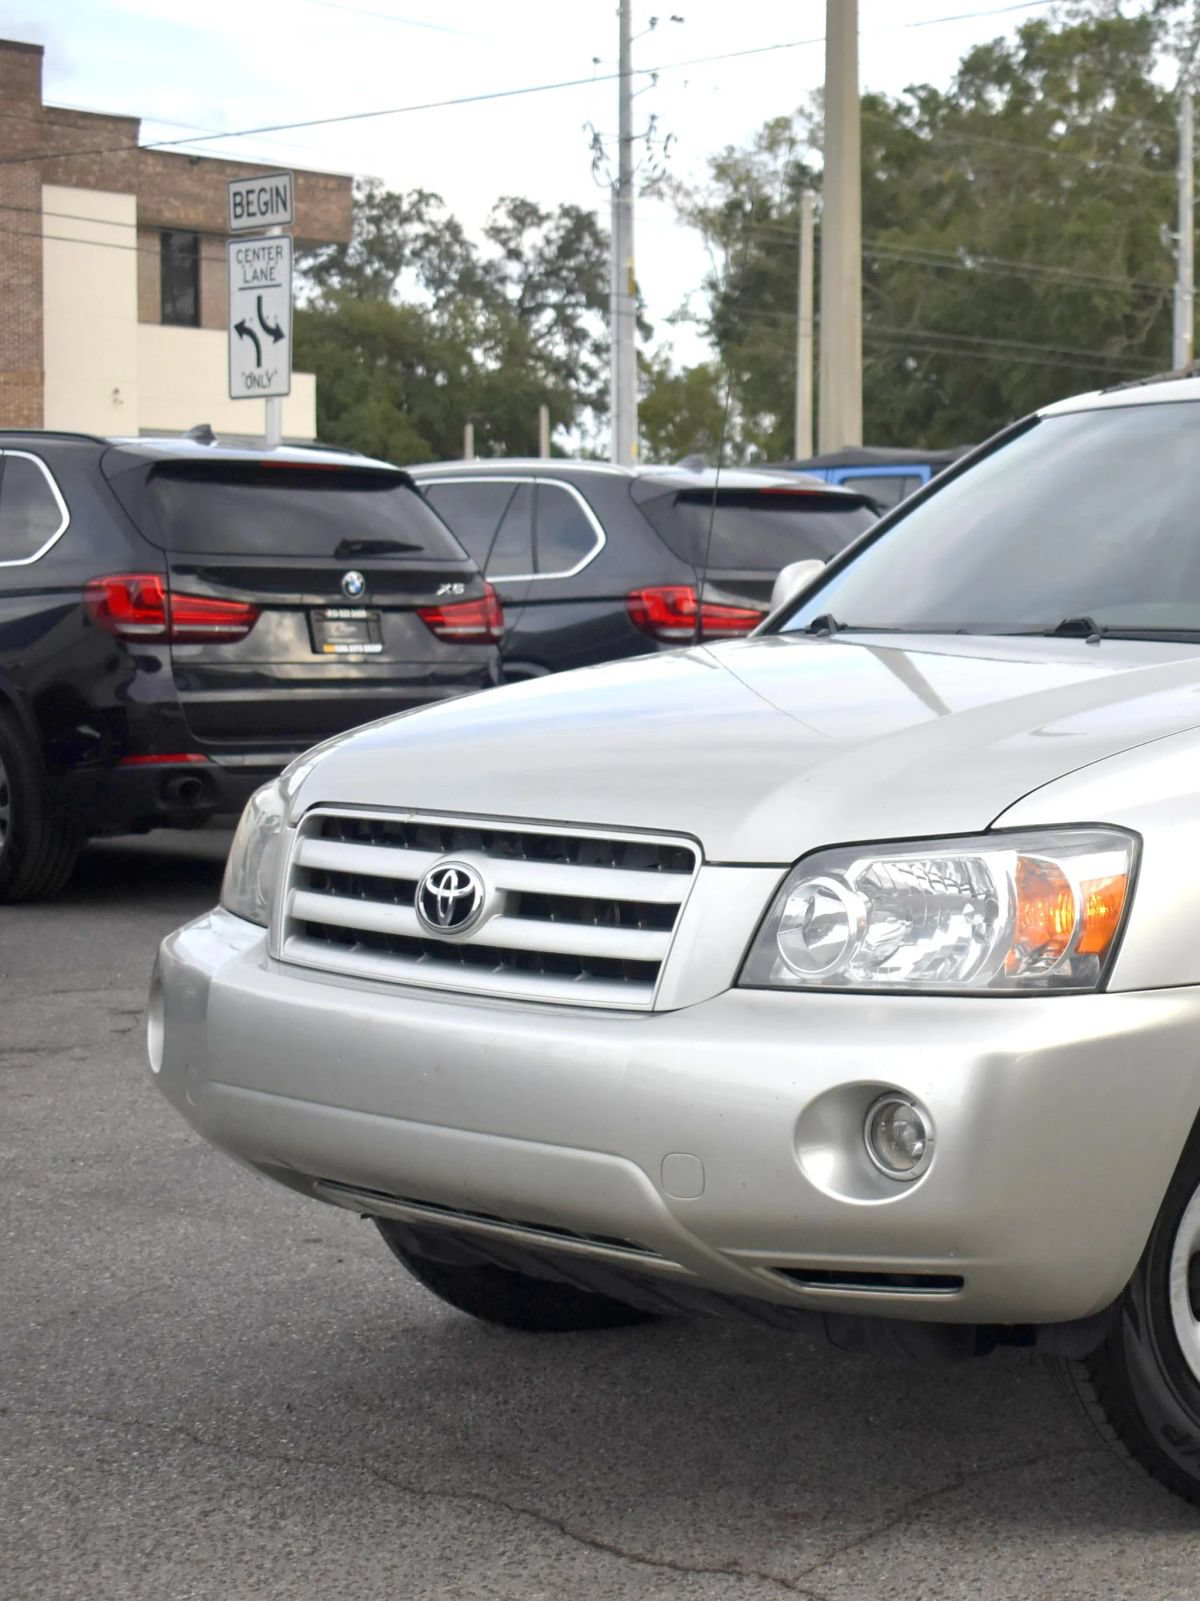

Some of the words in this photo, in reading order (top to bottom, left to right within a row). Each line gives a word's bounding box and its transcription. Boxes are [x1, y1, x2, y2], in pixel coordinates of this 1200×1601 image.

[232, 184, 288, 220] BEGIN
[236, 245, 284, 265] CENTER
[243, 265, 277, 285] LANE
[244, 372, 274, 390] ONLY
